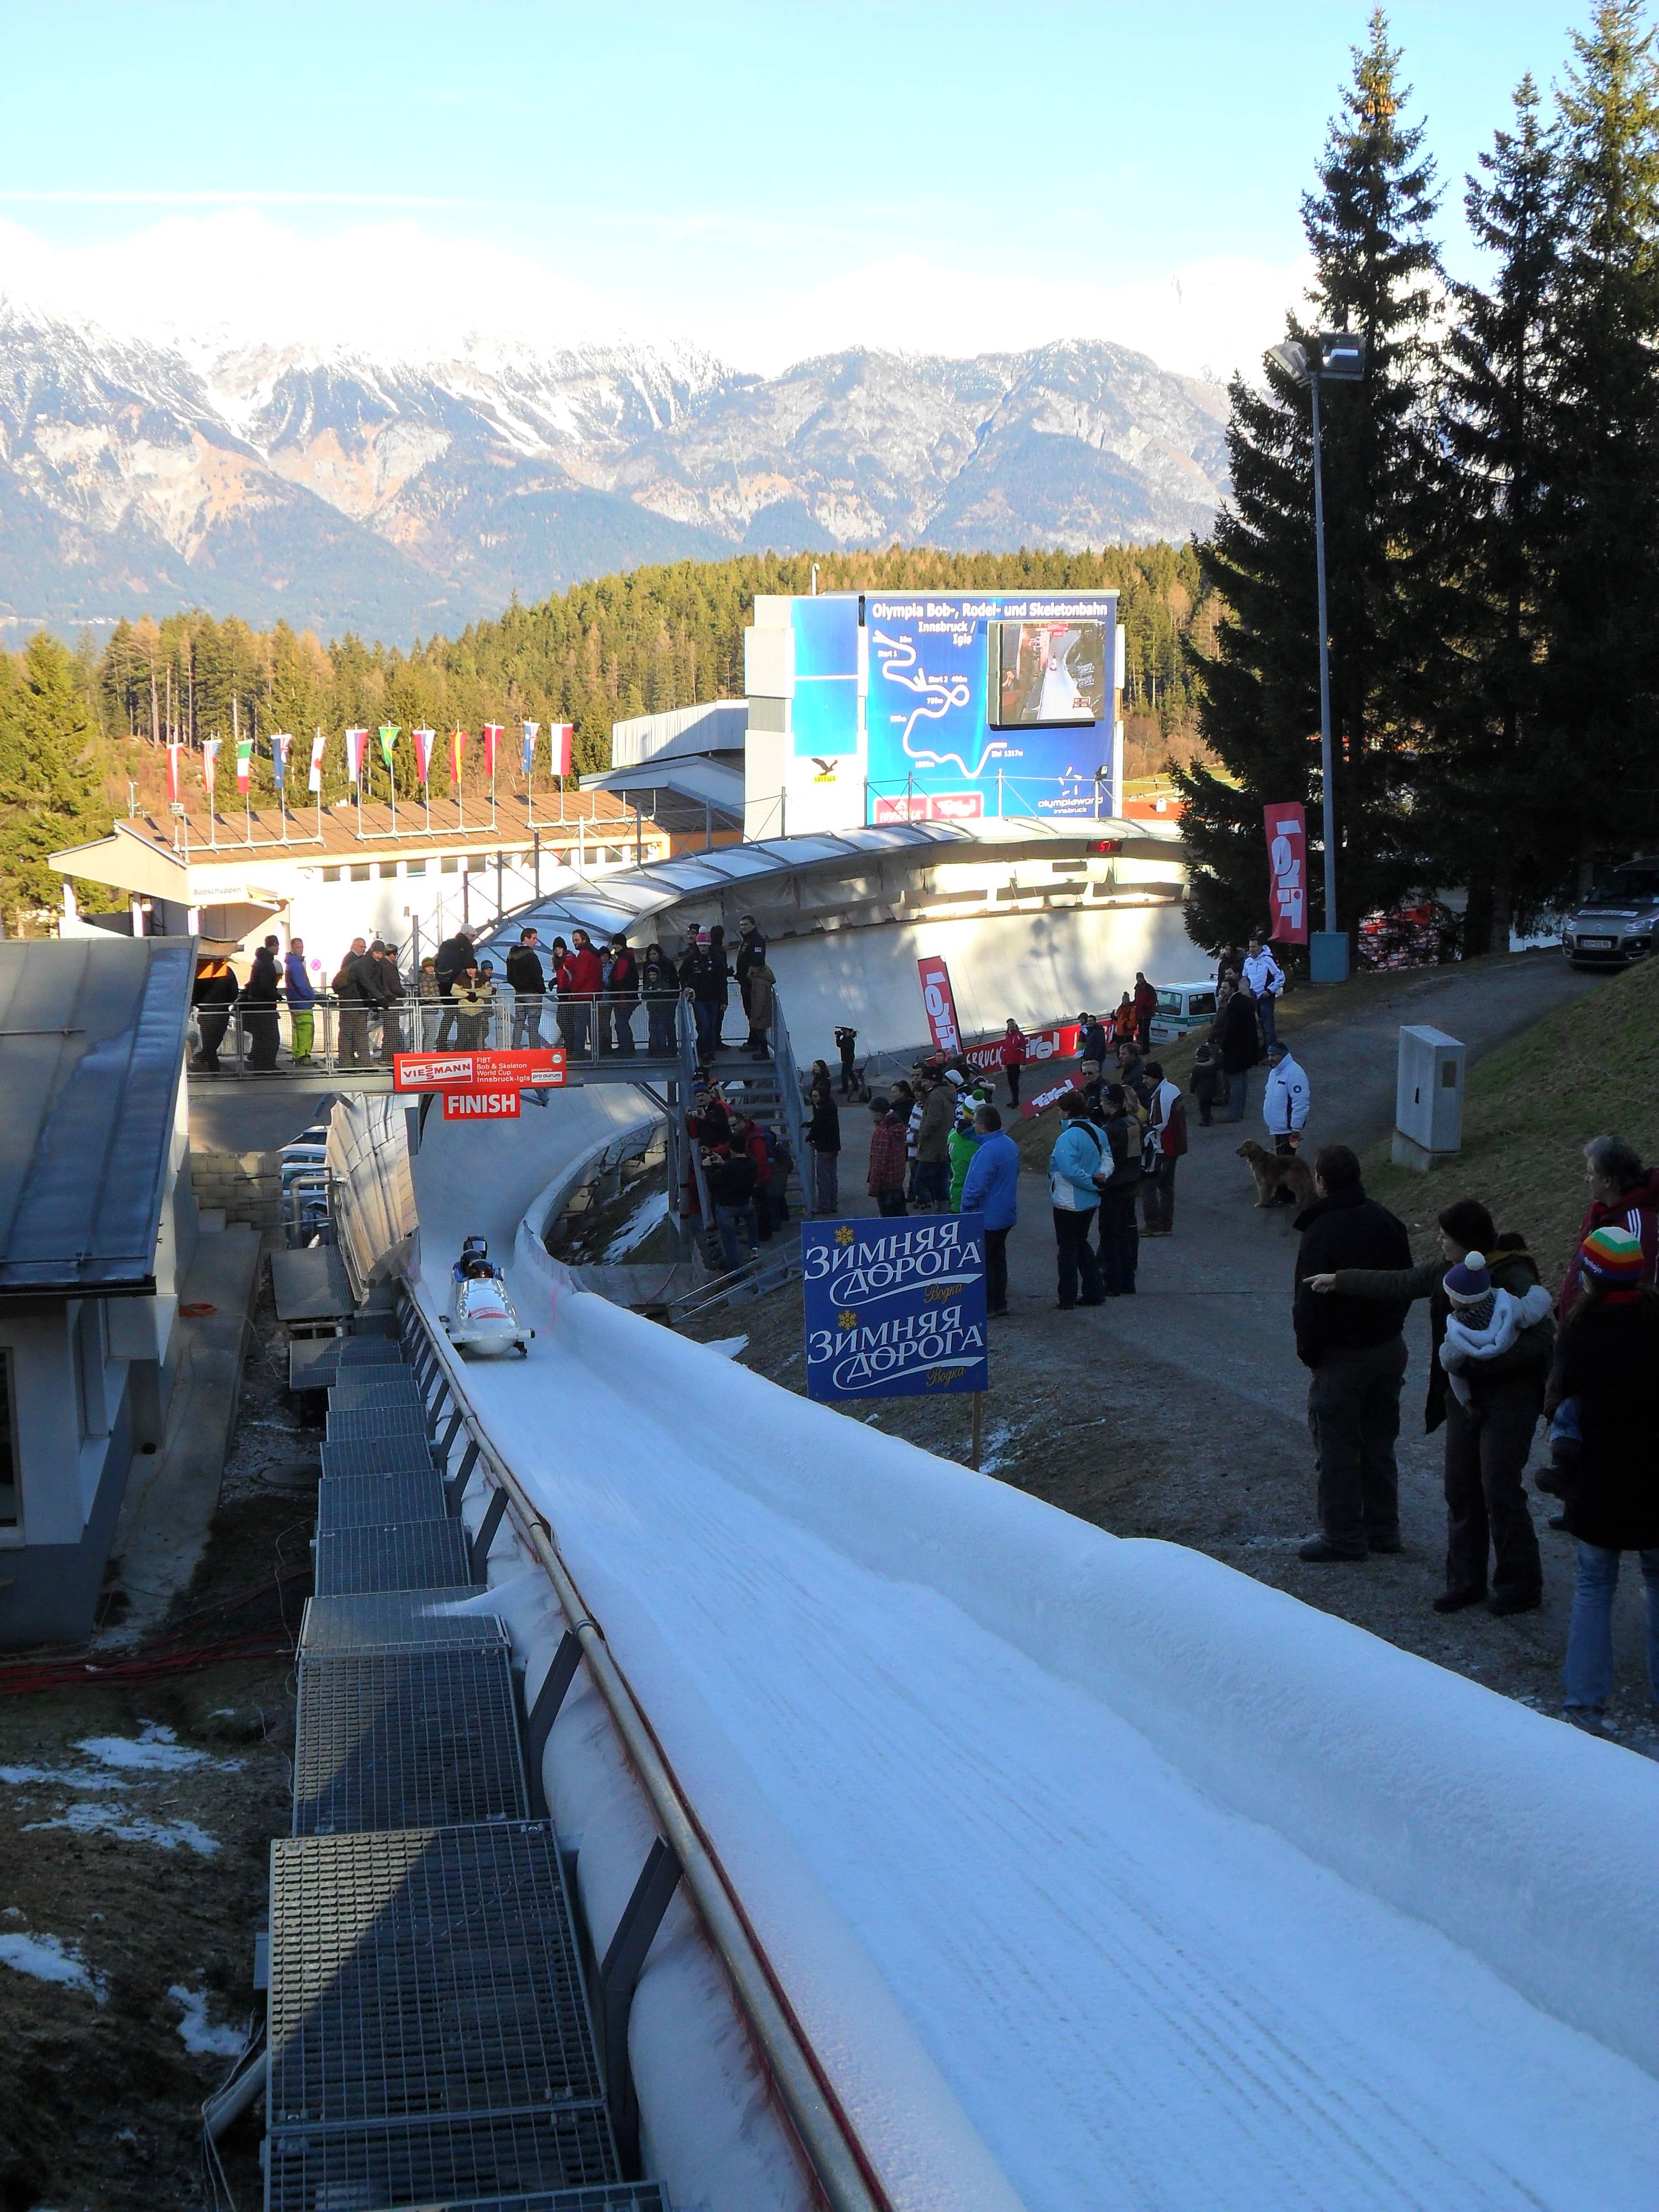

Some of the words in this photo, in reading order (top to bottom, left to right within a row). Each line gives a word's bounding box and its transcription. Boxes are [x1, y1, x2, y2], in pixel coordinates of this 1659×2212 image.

[873, 602, 924, 620] Olympia
[927, 602, 959, 619] Bob-,
[962, 602, 1001, 617] Rodel-
[1004, 602, 1026, 616] und
[1030, 601, 1108, 616] Skeletonbahn
[918, 621, 968, 633] Innsbruck
[953, 634, 972, 646] Igls
[1038, 796, 1103, 808] olympiaword
[1053, 806, 1088, 815] innsbruck
[1025, 1031, 1060, 1060] irol
[403, 1063, 470, 1079] VIESSMANN
[448, 1094, 515, 1114] FINISH
[804, 1220, 961, 1281] ЗИМНЯЯ
[839, 1241, 982, 1301] ДОРОГА
[924, 1282, 964, 1304] Водка
[808, 1305, 962, 1365] ЗИМНЯЯ
[843, 1325, 985, 1384] ДОРОГА
[926, 1365, 966, 1387] Водка
